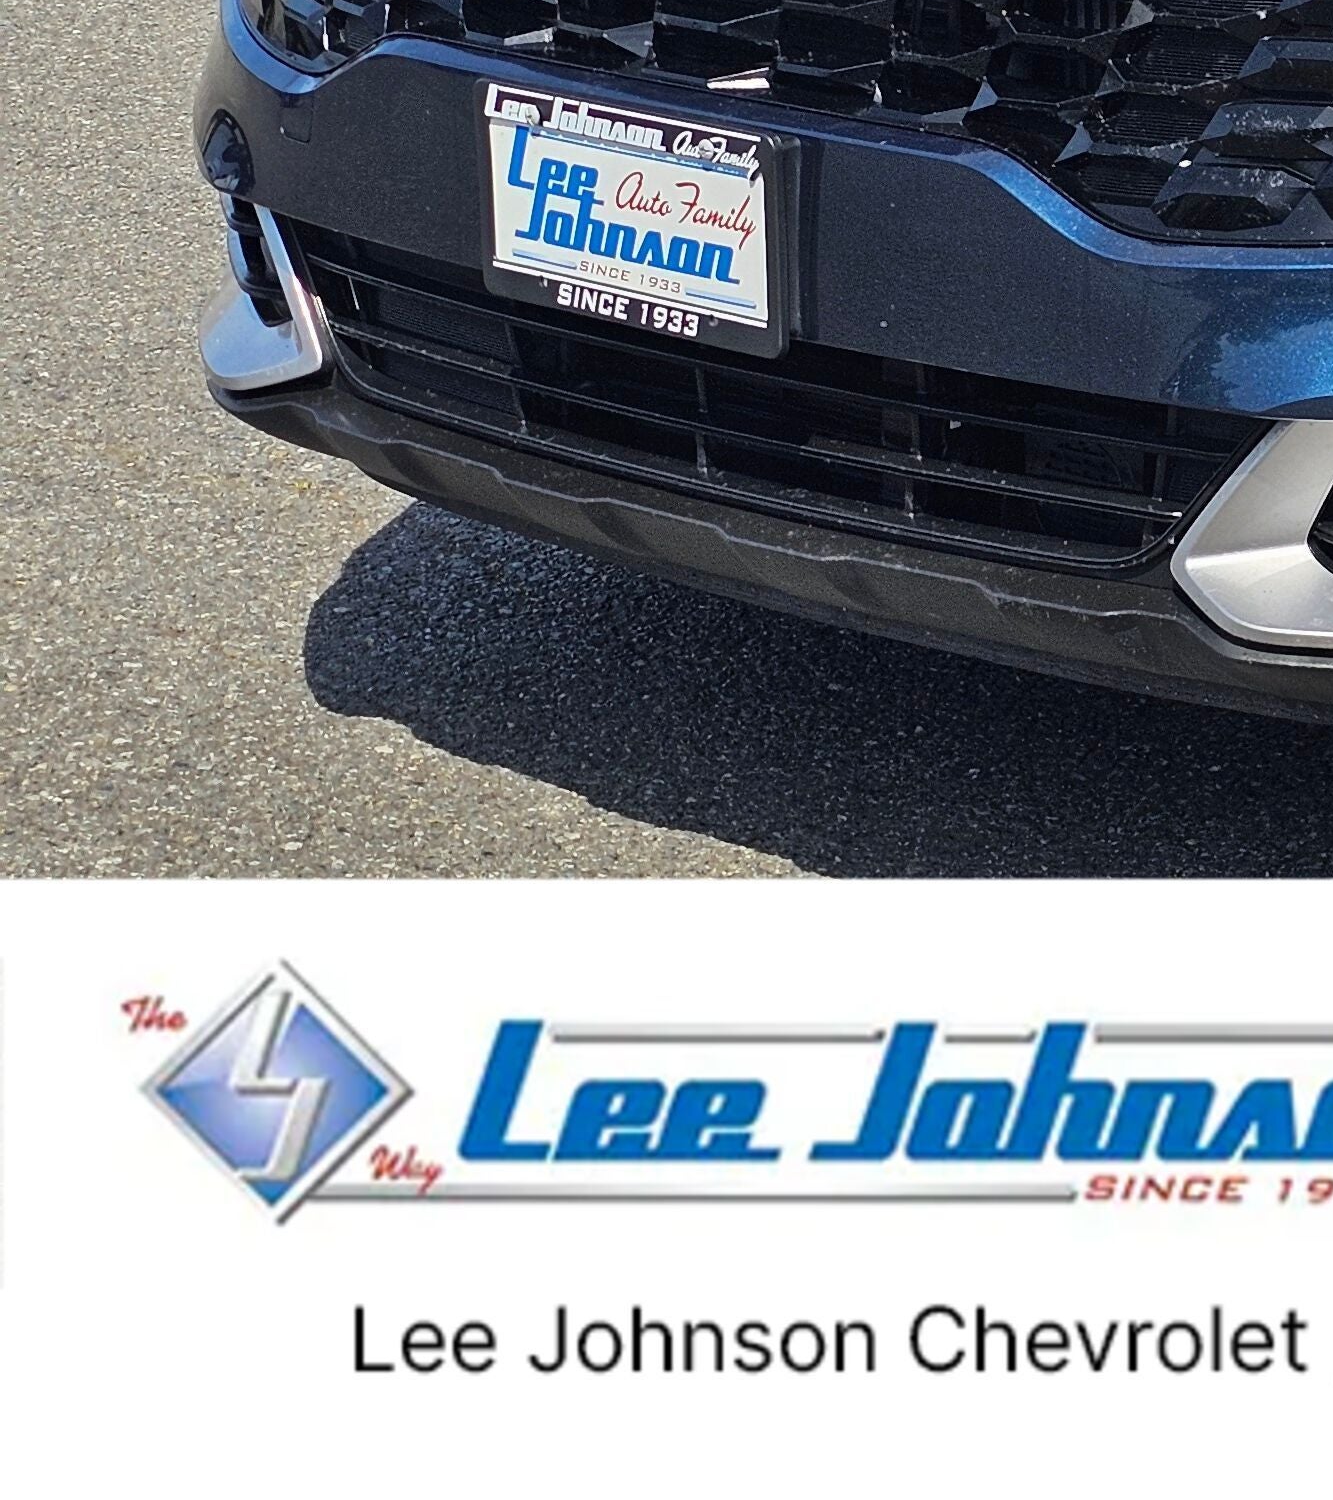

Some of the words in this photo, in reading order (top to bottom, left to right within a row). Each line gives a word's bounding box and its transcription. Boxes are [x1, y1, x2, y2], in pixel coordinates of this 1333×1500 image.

[543, 96, 667, 152] Johnson
[508, 126, 604, 205] Lee
[515, 192, 741, 286] Johnson
[615, 171, 672, 217] Auto
[675, 181, 757, 251] Family
[556, 282, 630, 321] SINCE
[638, 302, 700, 338] 1933
[579, 260, 631, 283] SINCE
[639, 273, 682, 295] 1933
